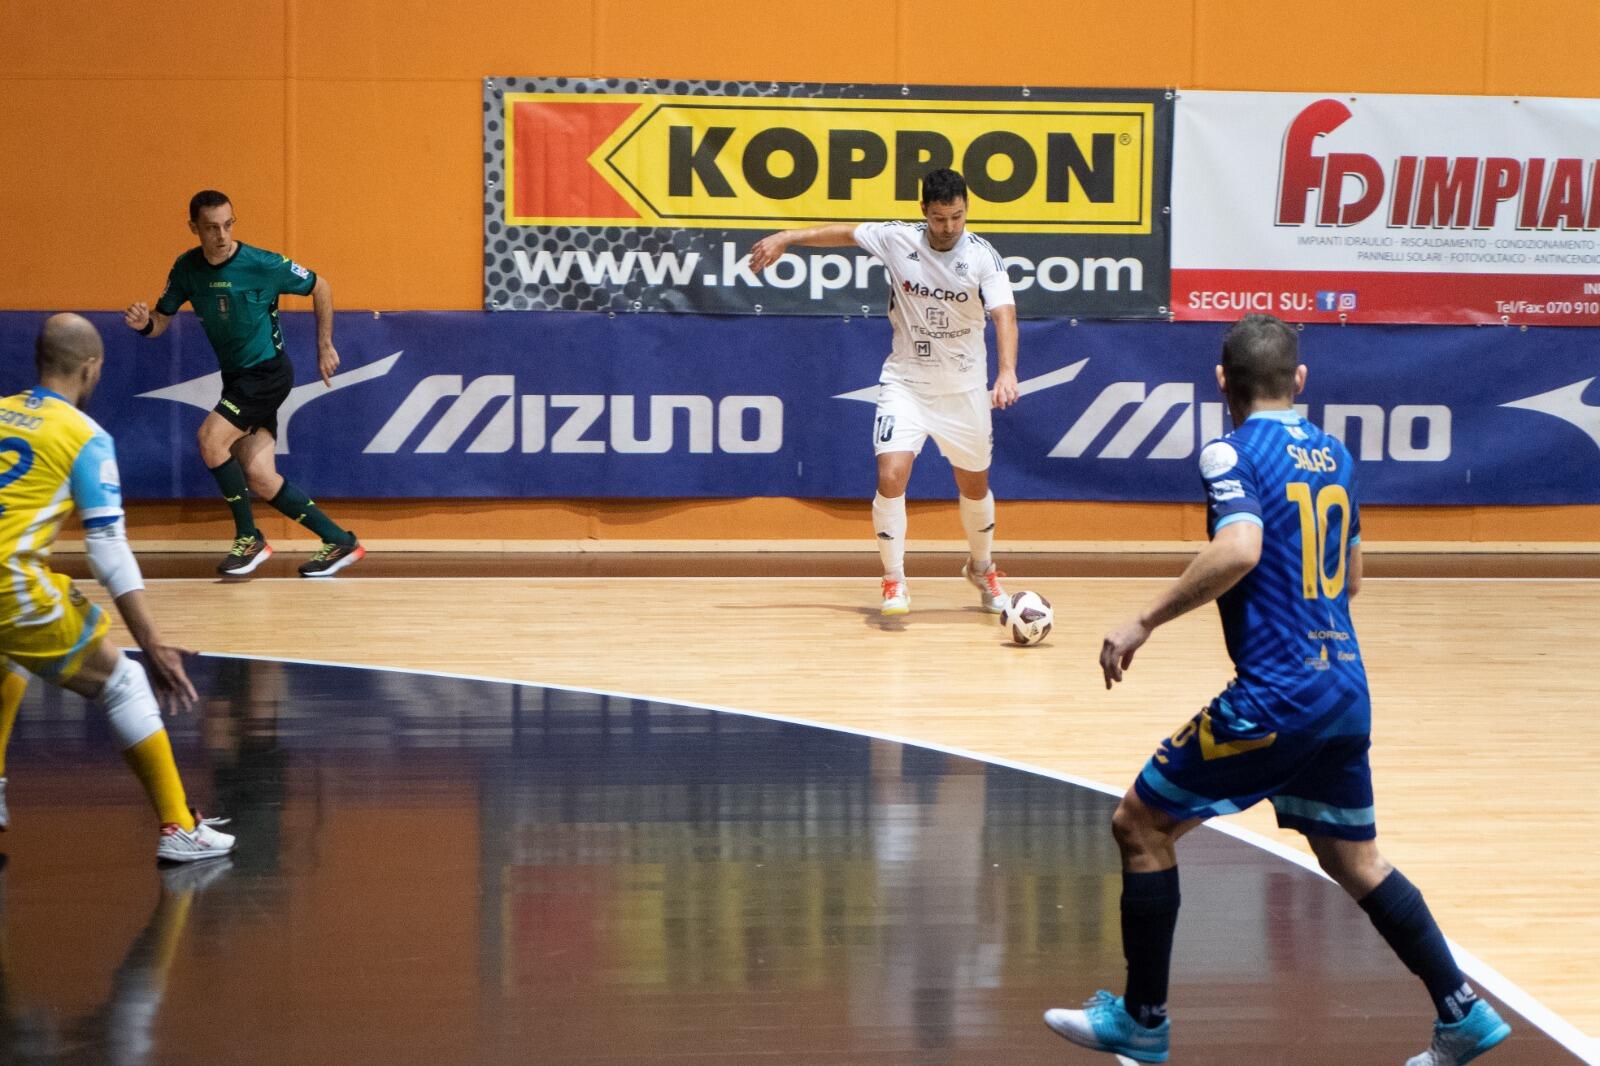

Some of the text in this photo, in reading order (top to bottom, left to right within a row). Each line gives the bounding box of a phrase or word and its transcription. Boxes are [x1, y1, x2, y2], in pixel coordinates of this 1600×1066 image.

[1386, 155, 1600, 232] IMPIA
[1297, 236, 1595, 250] IMPIANTI IDRAULICI RISCALDAMENTO CONDIZIONAMENTO
[1357, 251, 1404, 261] PANNELLI
[1406, 252, 1442, 262] SOLARI
[1450, 253, 1526, 264] FOTOVOLTAICO
[1188, 291, 1313, 311] SEGUICI SU:
[1546, 301, 1572, 314] 070
[1574, 301, 1599, 314] 910
[1286, 444, 1337, 472] SALAS
[1286, 482, 1350, 600] 10
